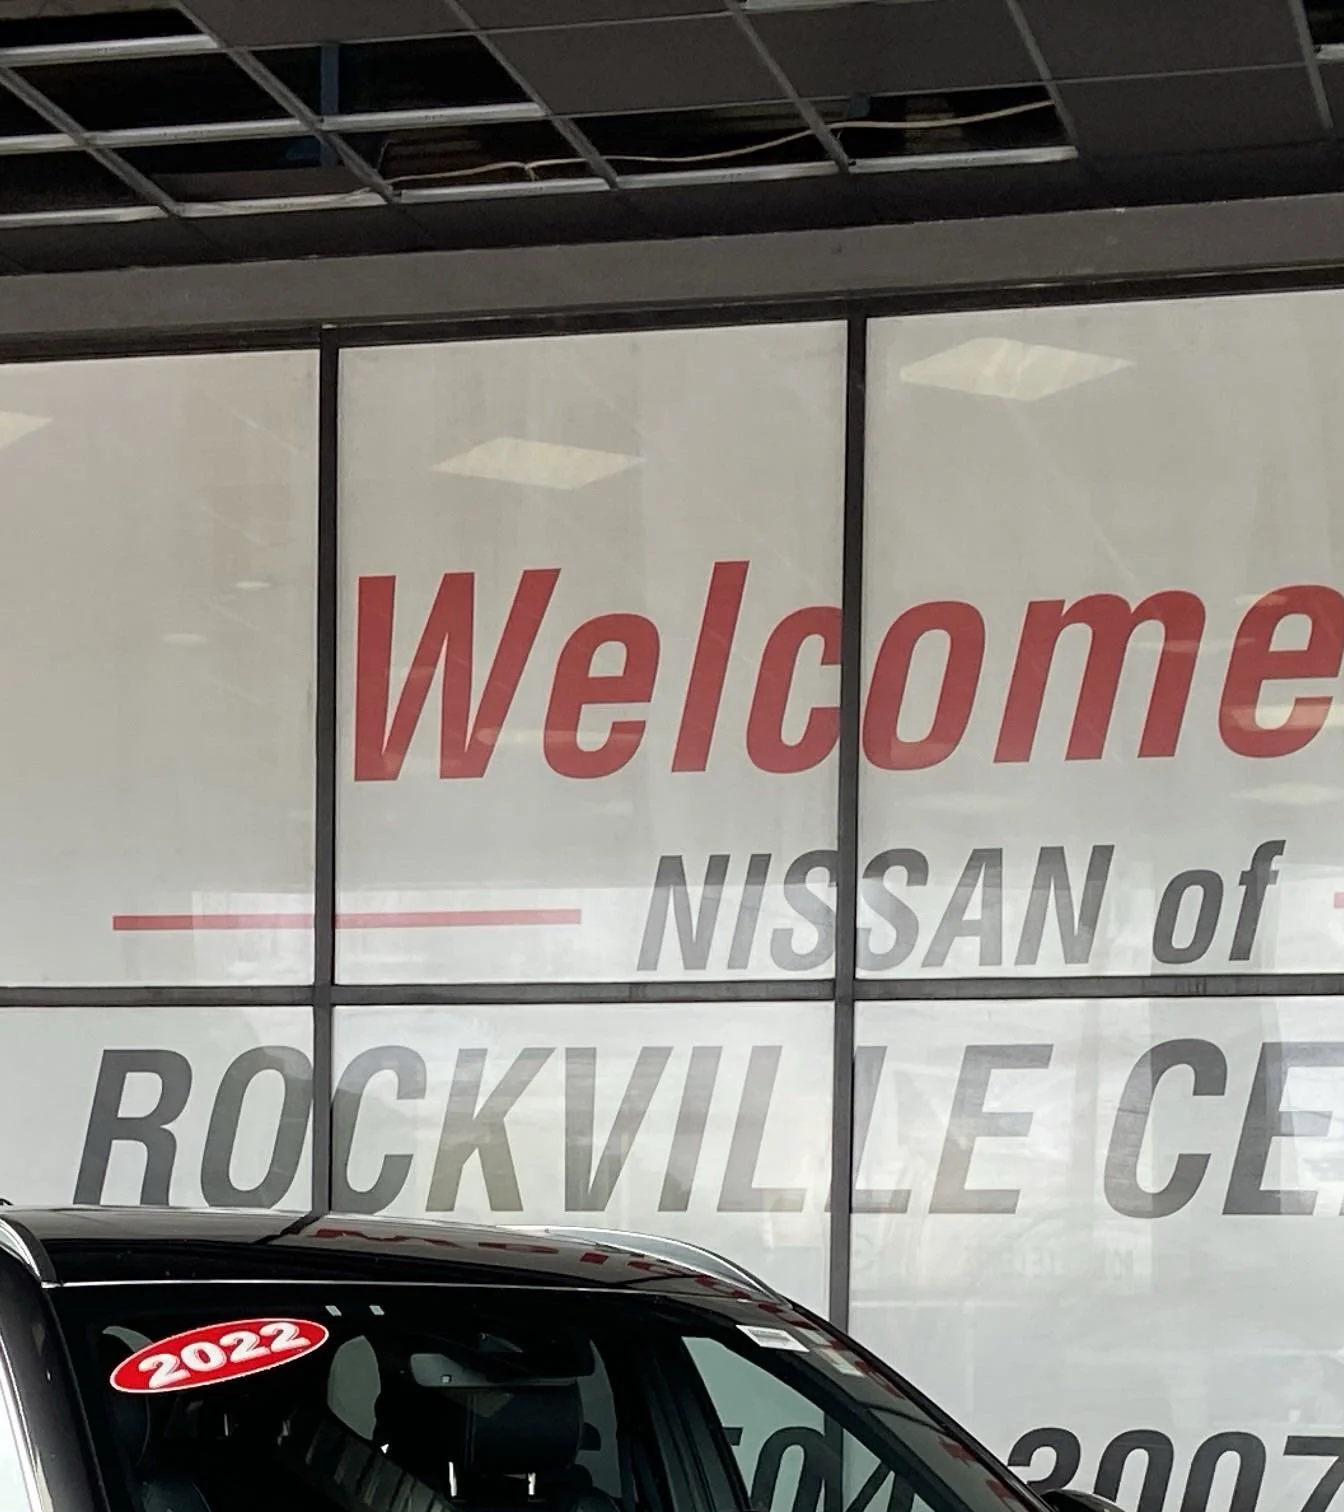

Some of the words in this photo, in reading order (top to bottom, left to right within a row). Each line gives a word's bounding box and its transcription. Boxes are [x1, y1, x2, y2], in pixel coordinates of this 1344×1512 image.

[636, 842, 1115, 972] NISSAN
[1151, 838, 1286, 966] of
[72, 1044, 1054, 1219] ROCKVILLE
[138, 1321, 312, 1389] 2022
